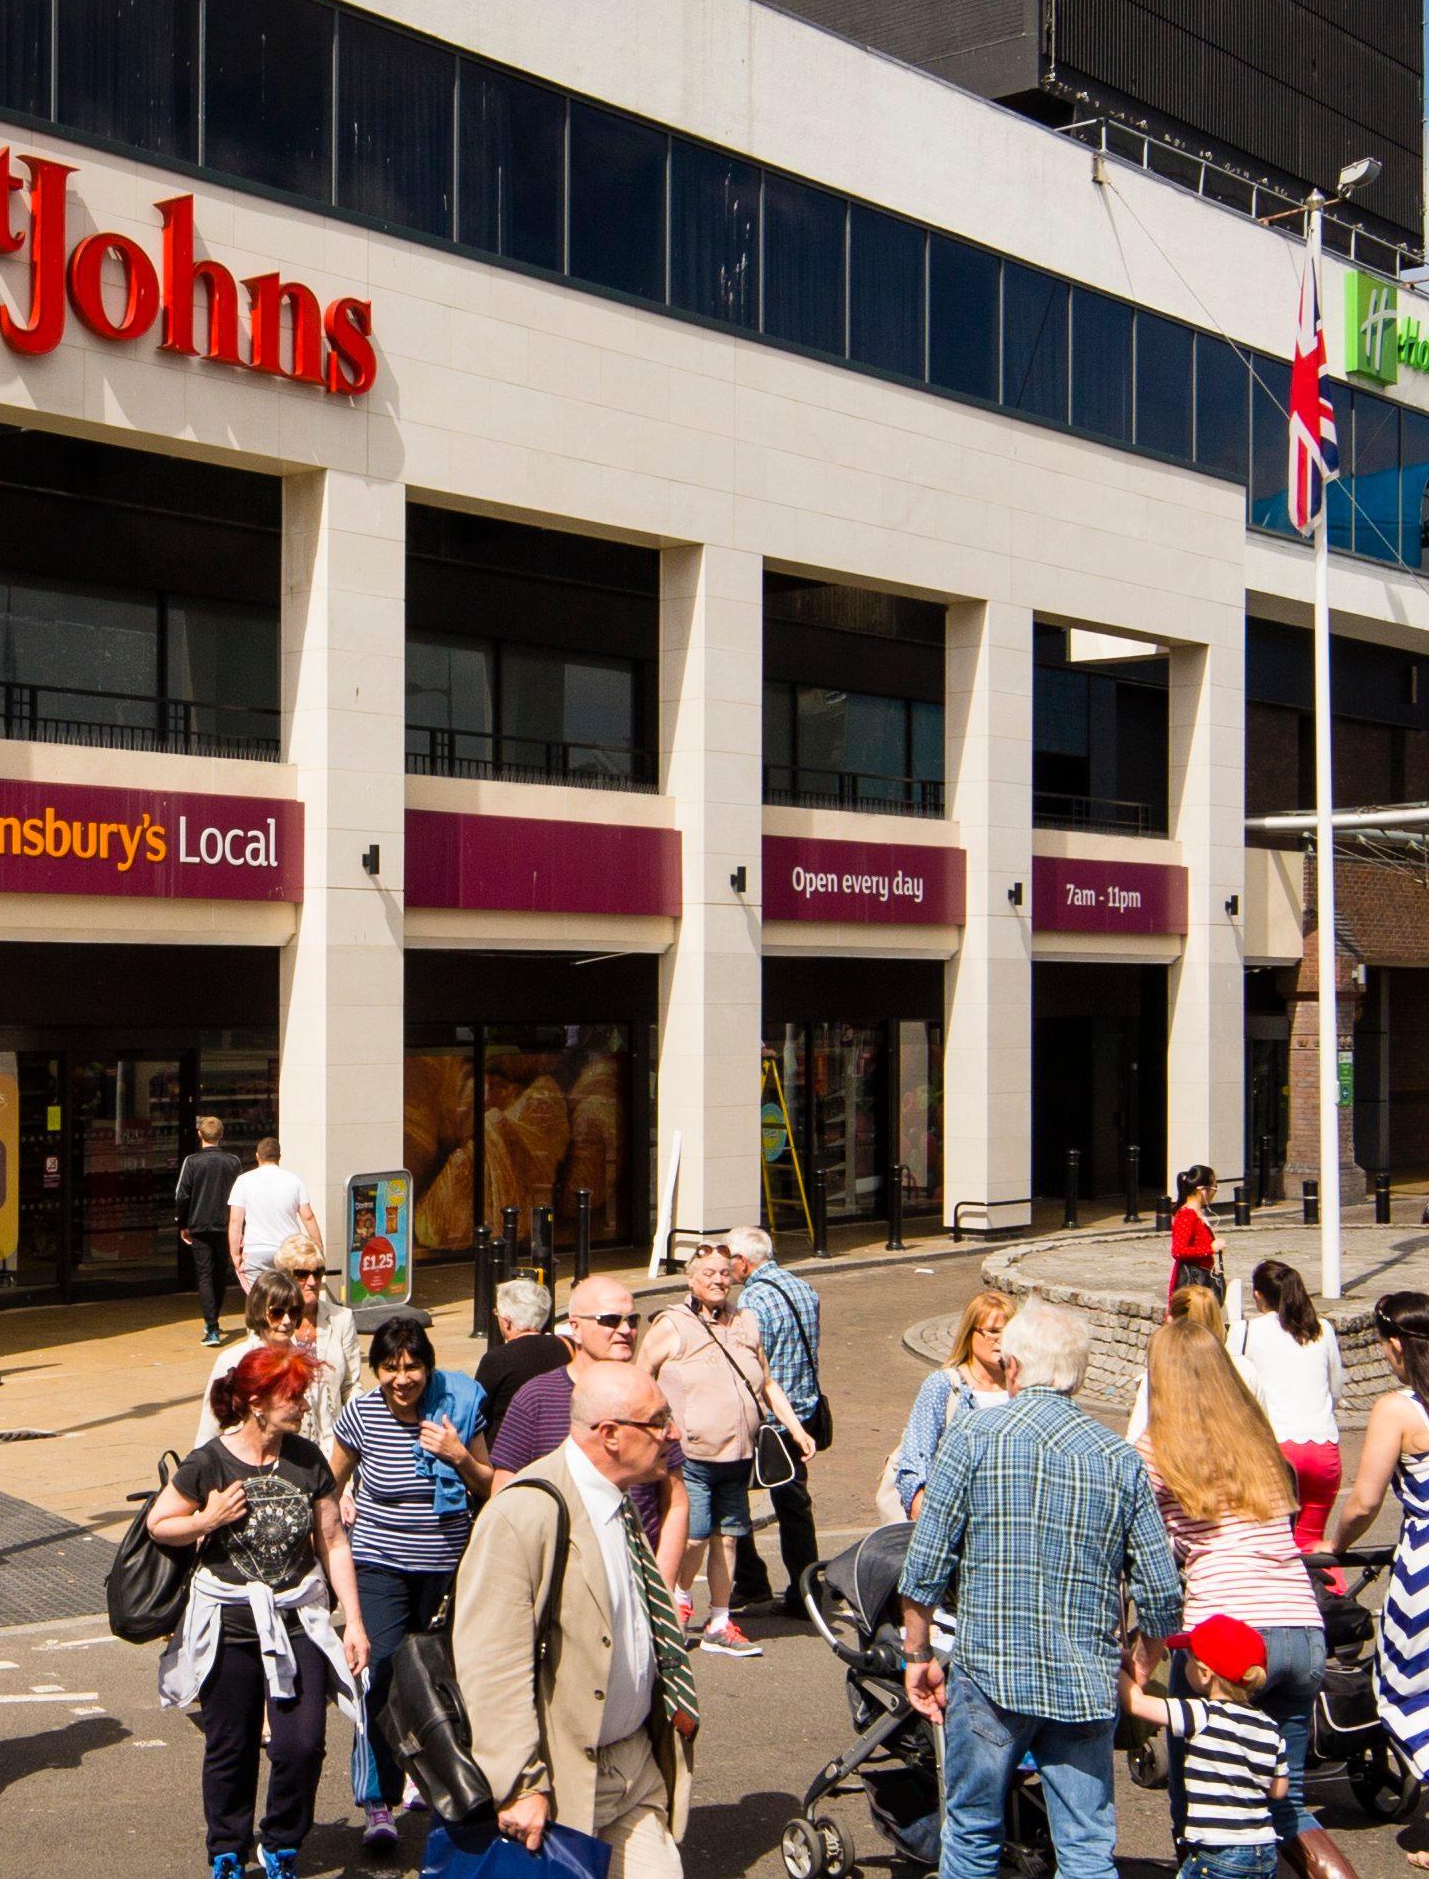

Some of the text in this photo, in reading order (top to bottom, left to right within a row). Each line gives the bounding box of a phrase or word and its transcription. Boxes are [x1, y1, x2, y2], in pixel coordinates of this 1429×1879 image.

[179, 816, 278, 868] Local
[792, 866, 923, 902] Open every day
[1066, 883, 1095, 906] 7am
[1107, 886, 1141, 913] 11pm
[363, 1253, 393, 1271] £1.25
